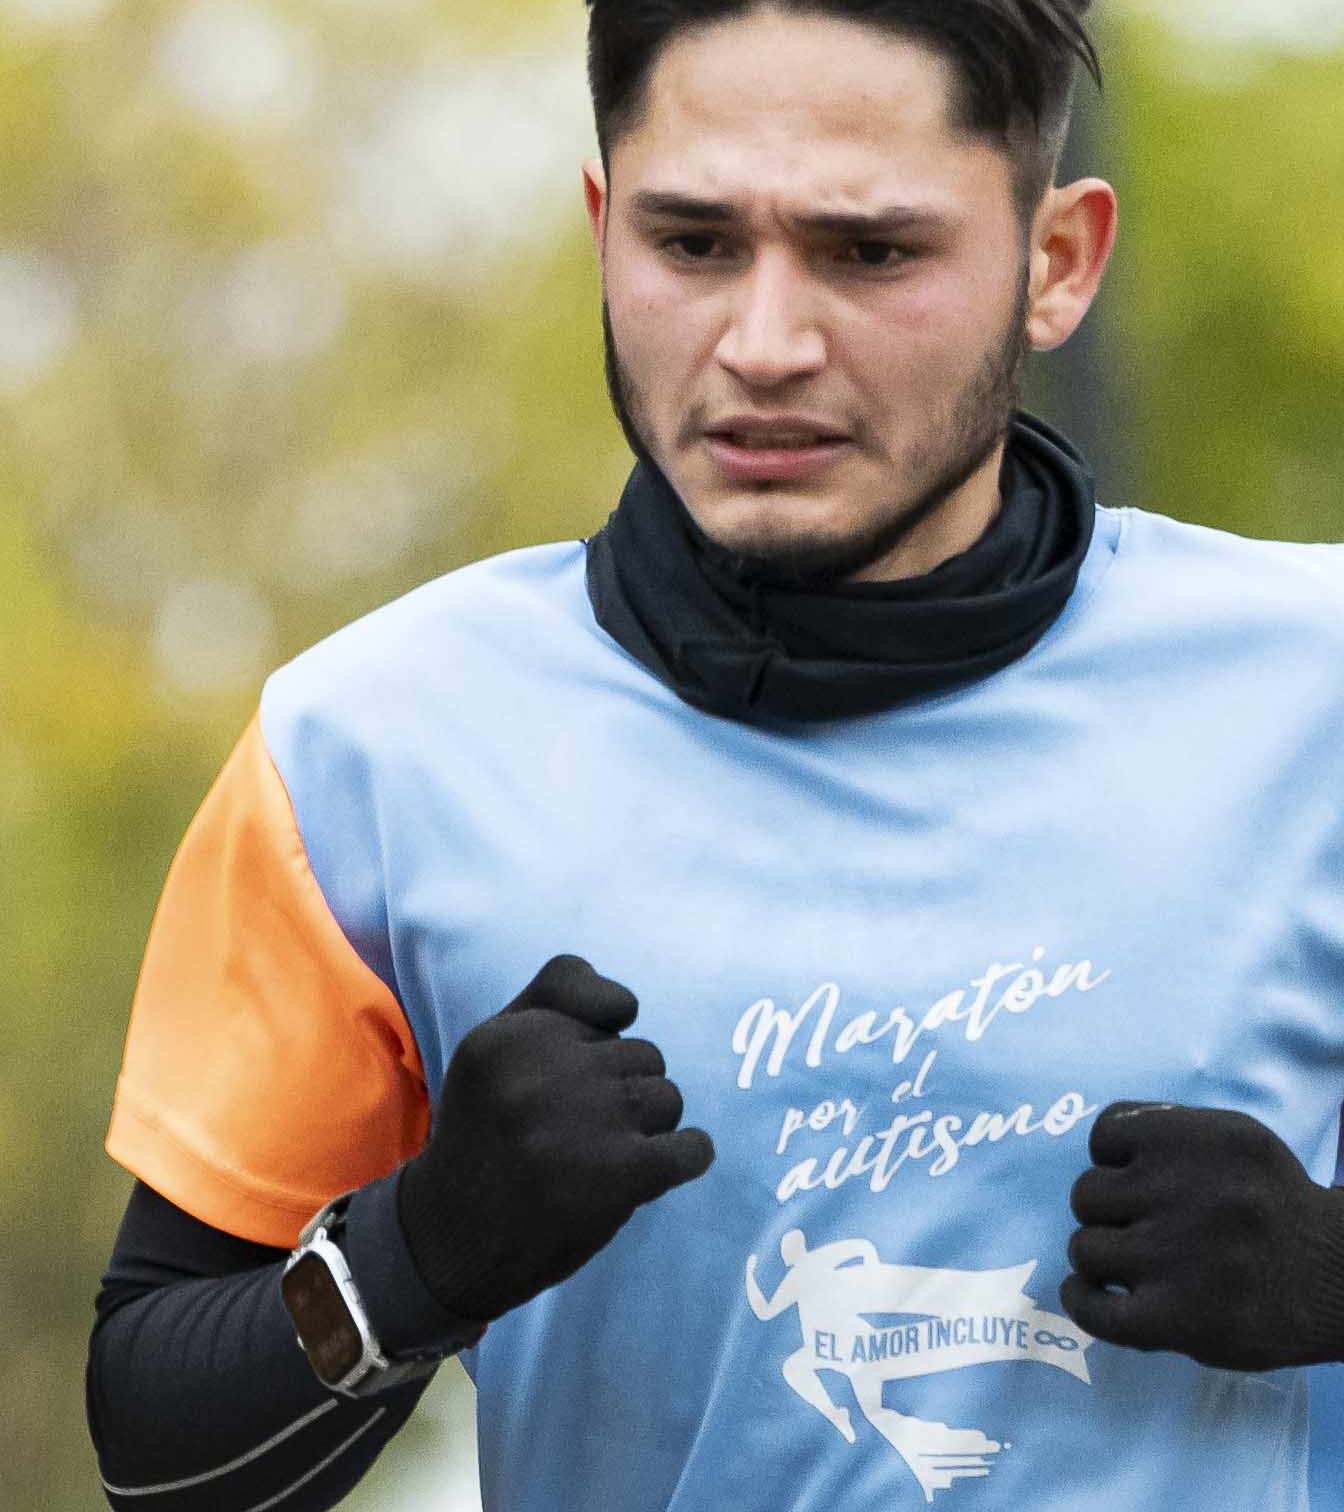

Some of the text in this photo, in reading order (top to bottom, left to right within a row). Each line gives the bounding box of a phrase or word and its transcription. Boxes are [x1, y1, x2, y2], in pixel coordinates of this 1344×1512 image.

[732, 945, 1112, 1090] Maratón
[776, 1049, 938, 1155] por el
[776, 1091, 1098, 1204] autismo
[815, 1315, 1030, 1363] EL AMOR INCLUYE
